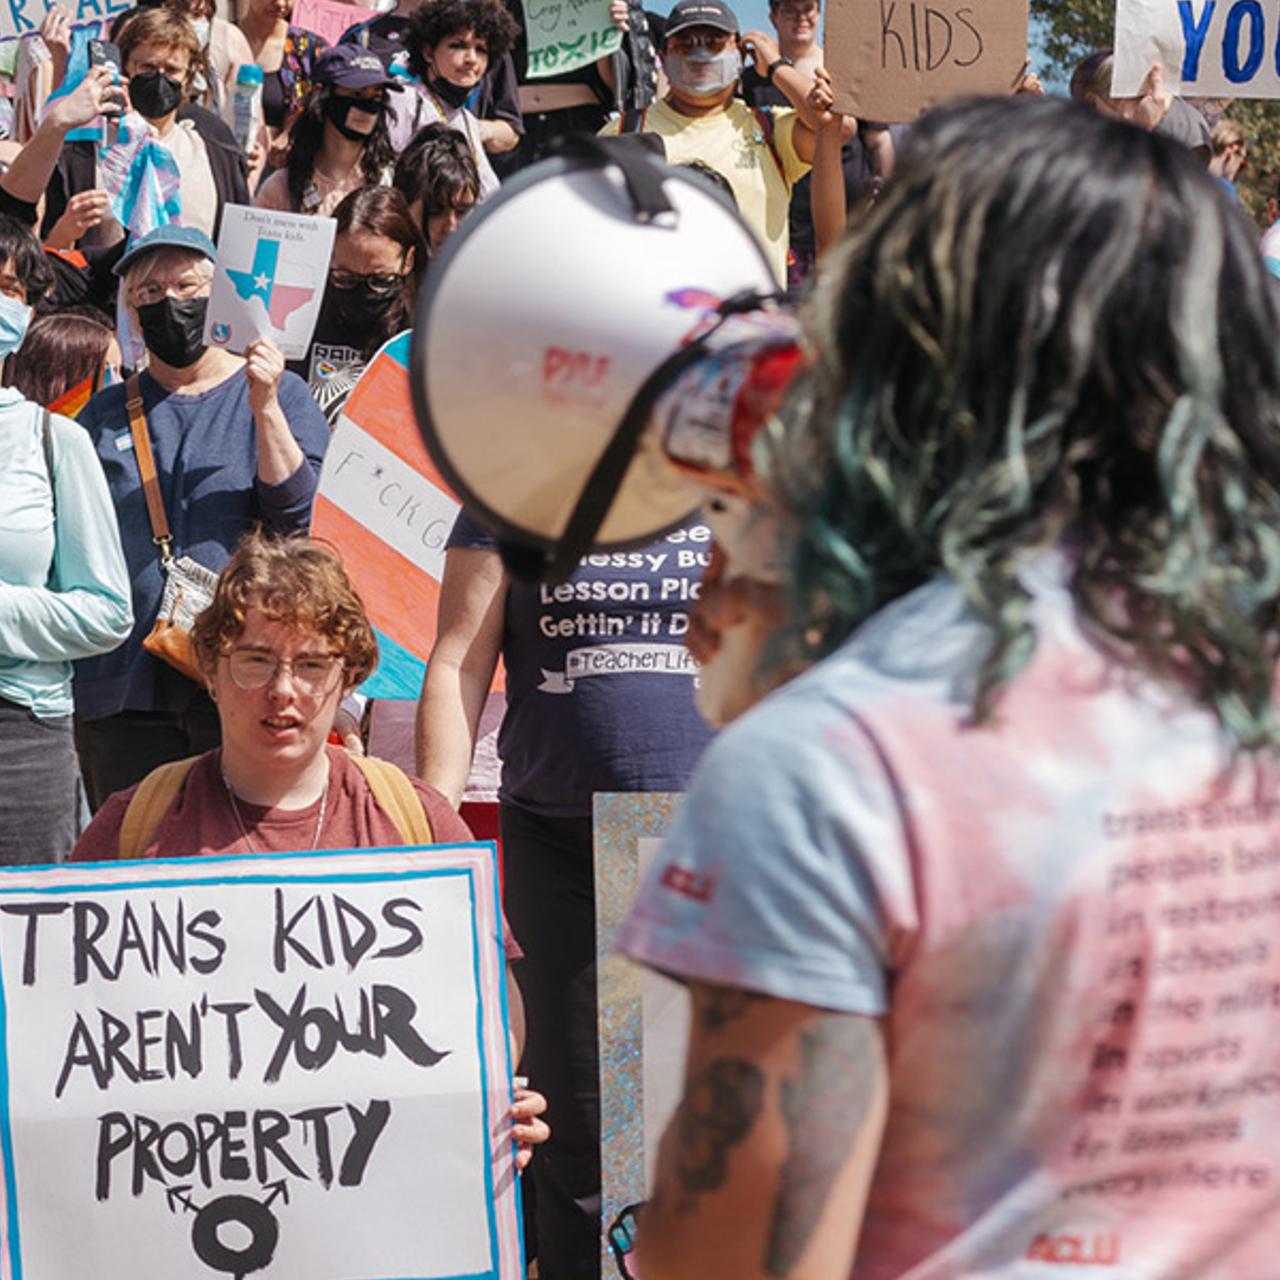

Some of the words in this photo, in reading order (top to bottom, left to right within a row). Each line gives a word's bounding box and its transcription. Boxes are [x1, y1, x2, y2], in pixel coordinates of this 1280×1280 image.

[528, 25, 619, 73] TOXIC
[881, 0, 983, 71] KIDS
[1177, 0, 1280, 83] YO
[541, 581, 649, 604] Lesson
[580, 551, 668, 572] essy
[540, 613, 633, 637] Gettin'
[641, 613, 662, 635] it
[0, 898, 226, 985] TRANS
[273, 888, 424, 972] KIDS
[55, 993, 251, 1098] AREN'T
[255, 983, 451, 1084] YOUR
[96, 1100, 391, 1202] PROPERTY
